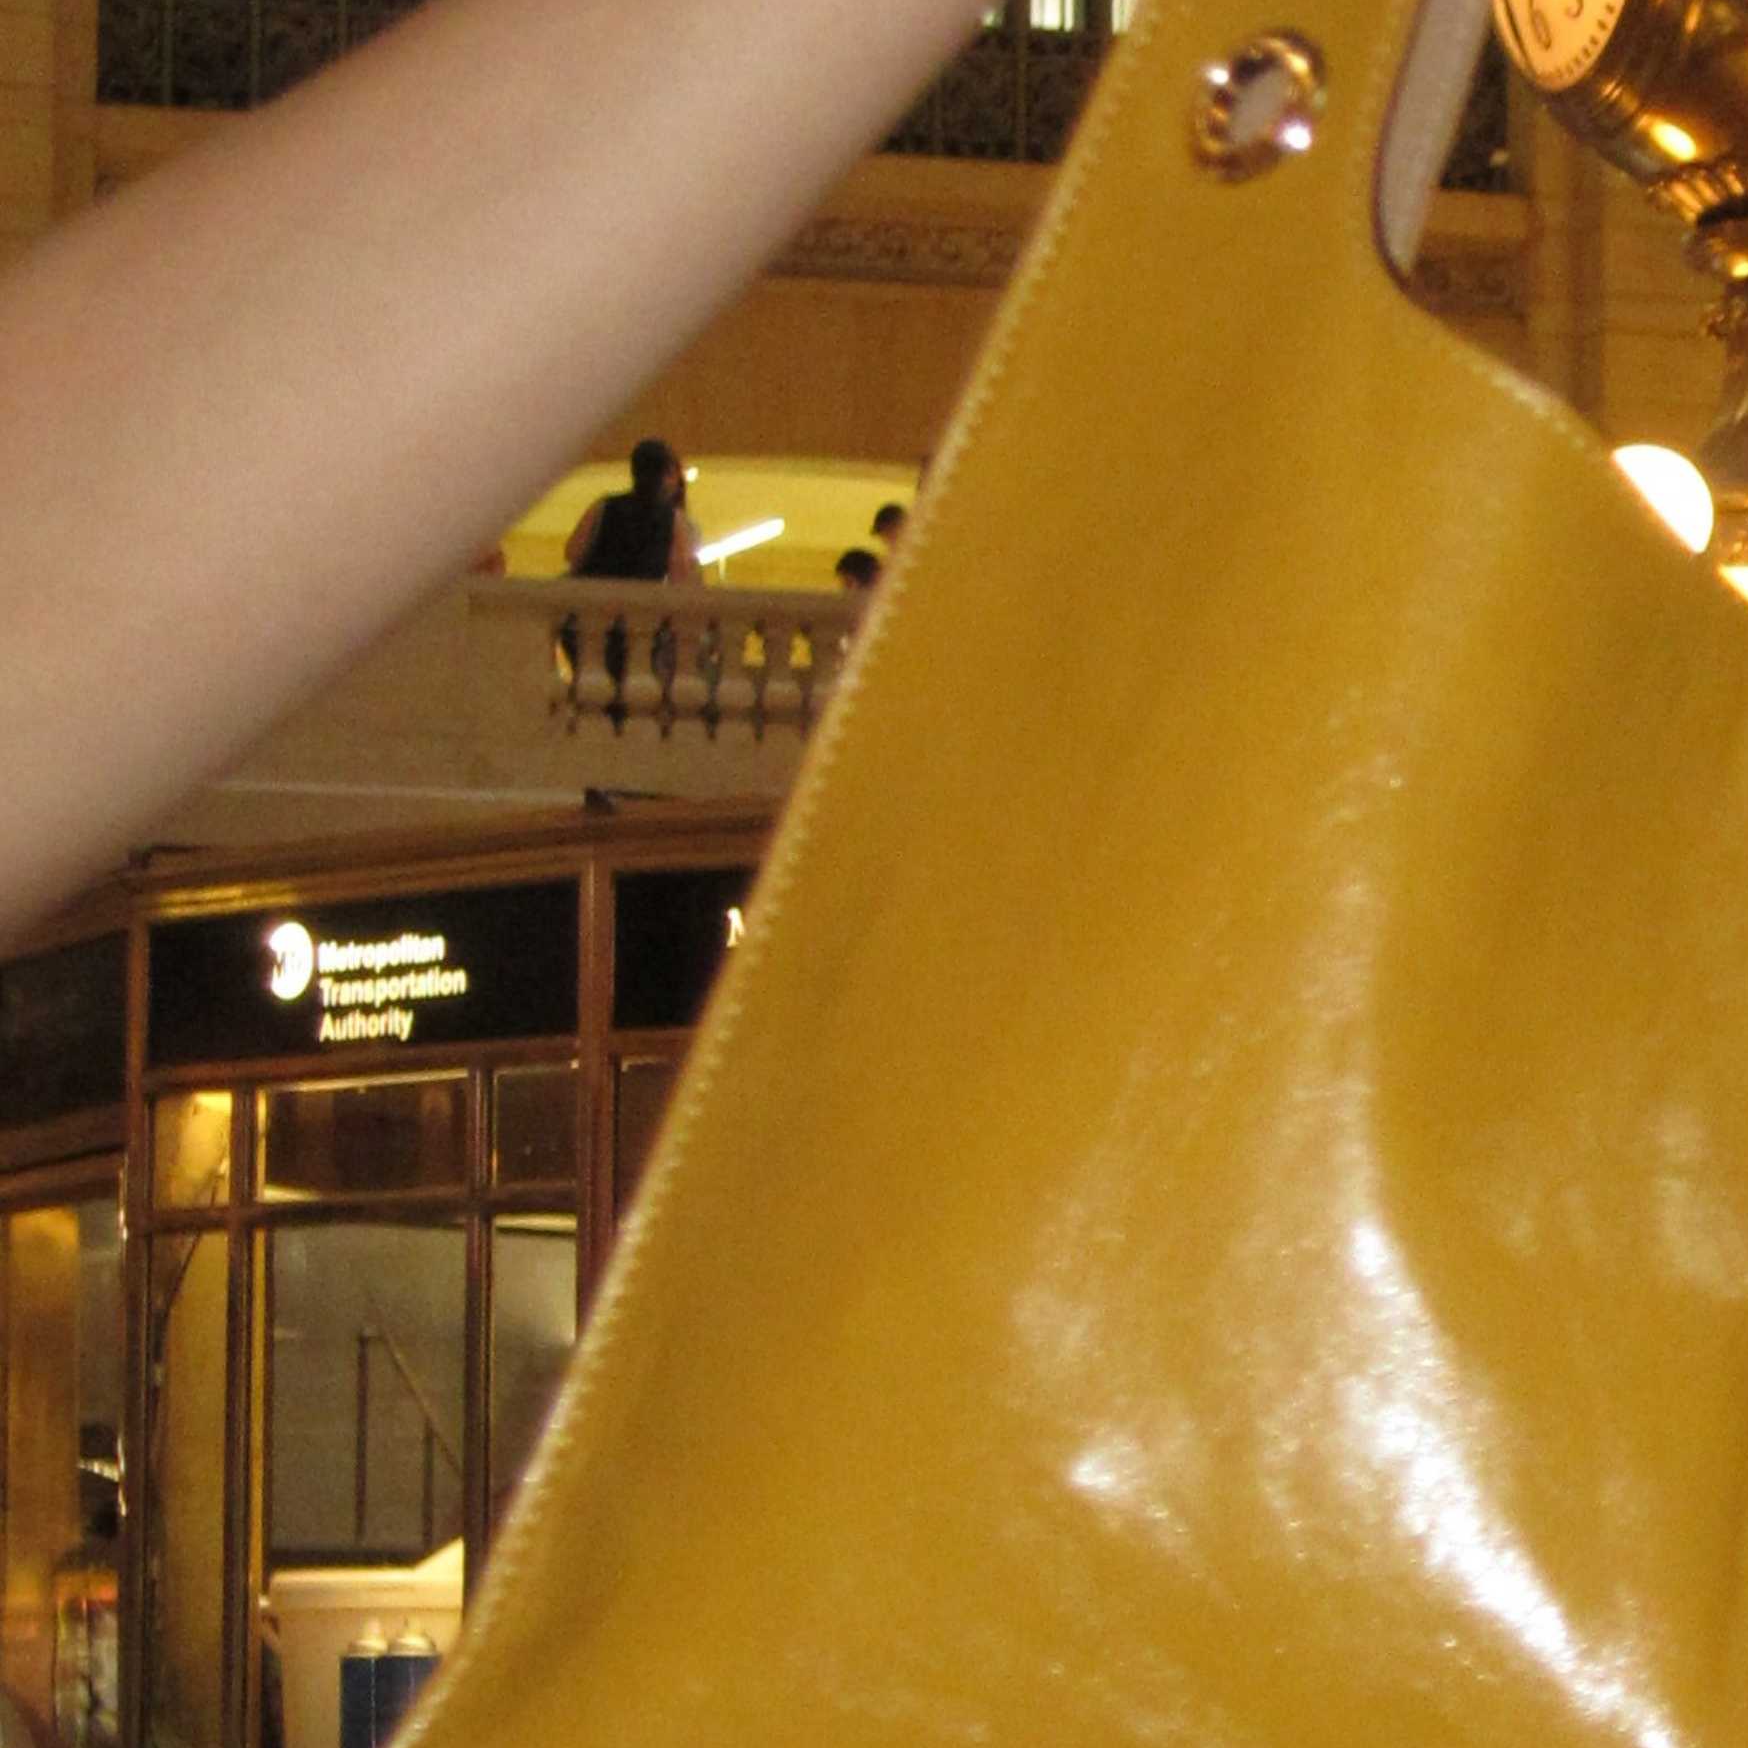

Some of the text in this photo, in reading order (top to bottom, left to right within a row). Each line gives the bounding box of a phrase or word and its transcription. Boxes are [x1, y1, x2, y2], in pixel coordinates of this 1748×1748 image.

[318, 933, 446, 974] Metropolitan
[318, 966, 468, 1009] Transportation
[318, 1006, 415, 1043] Authority
